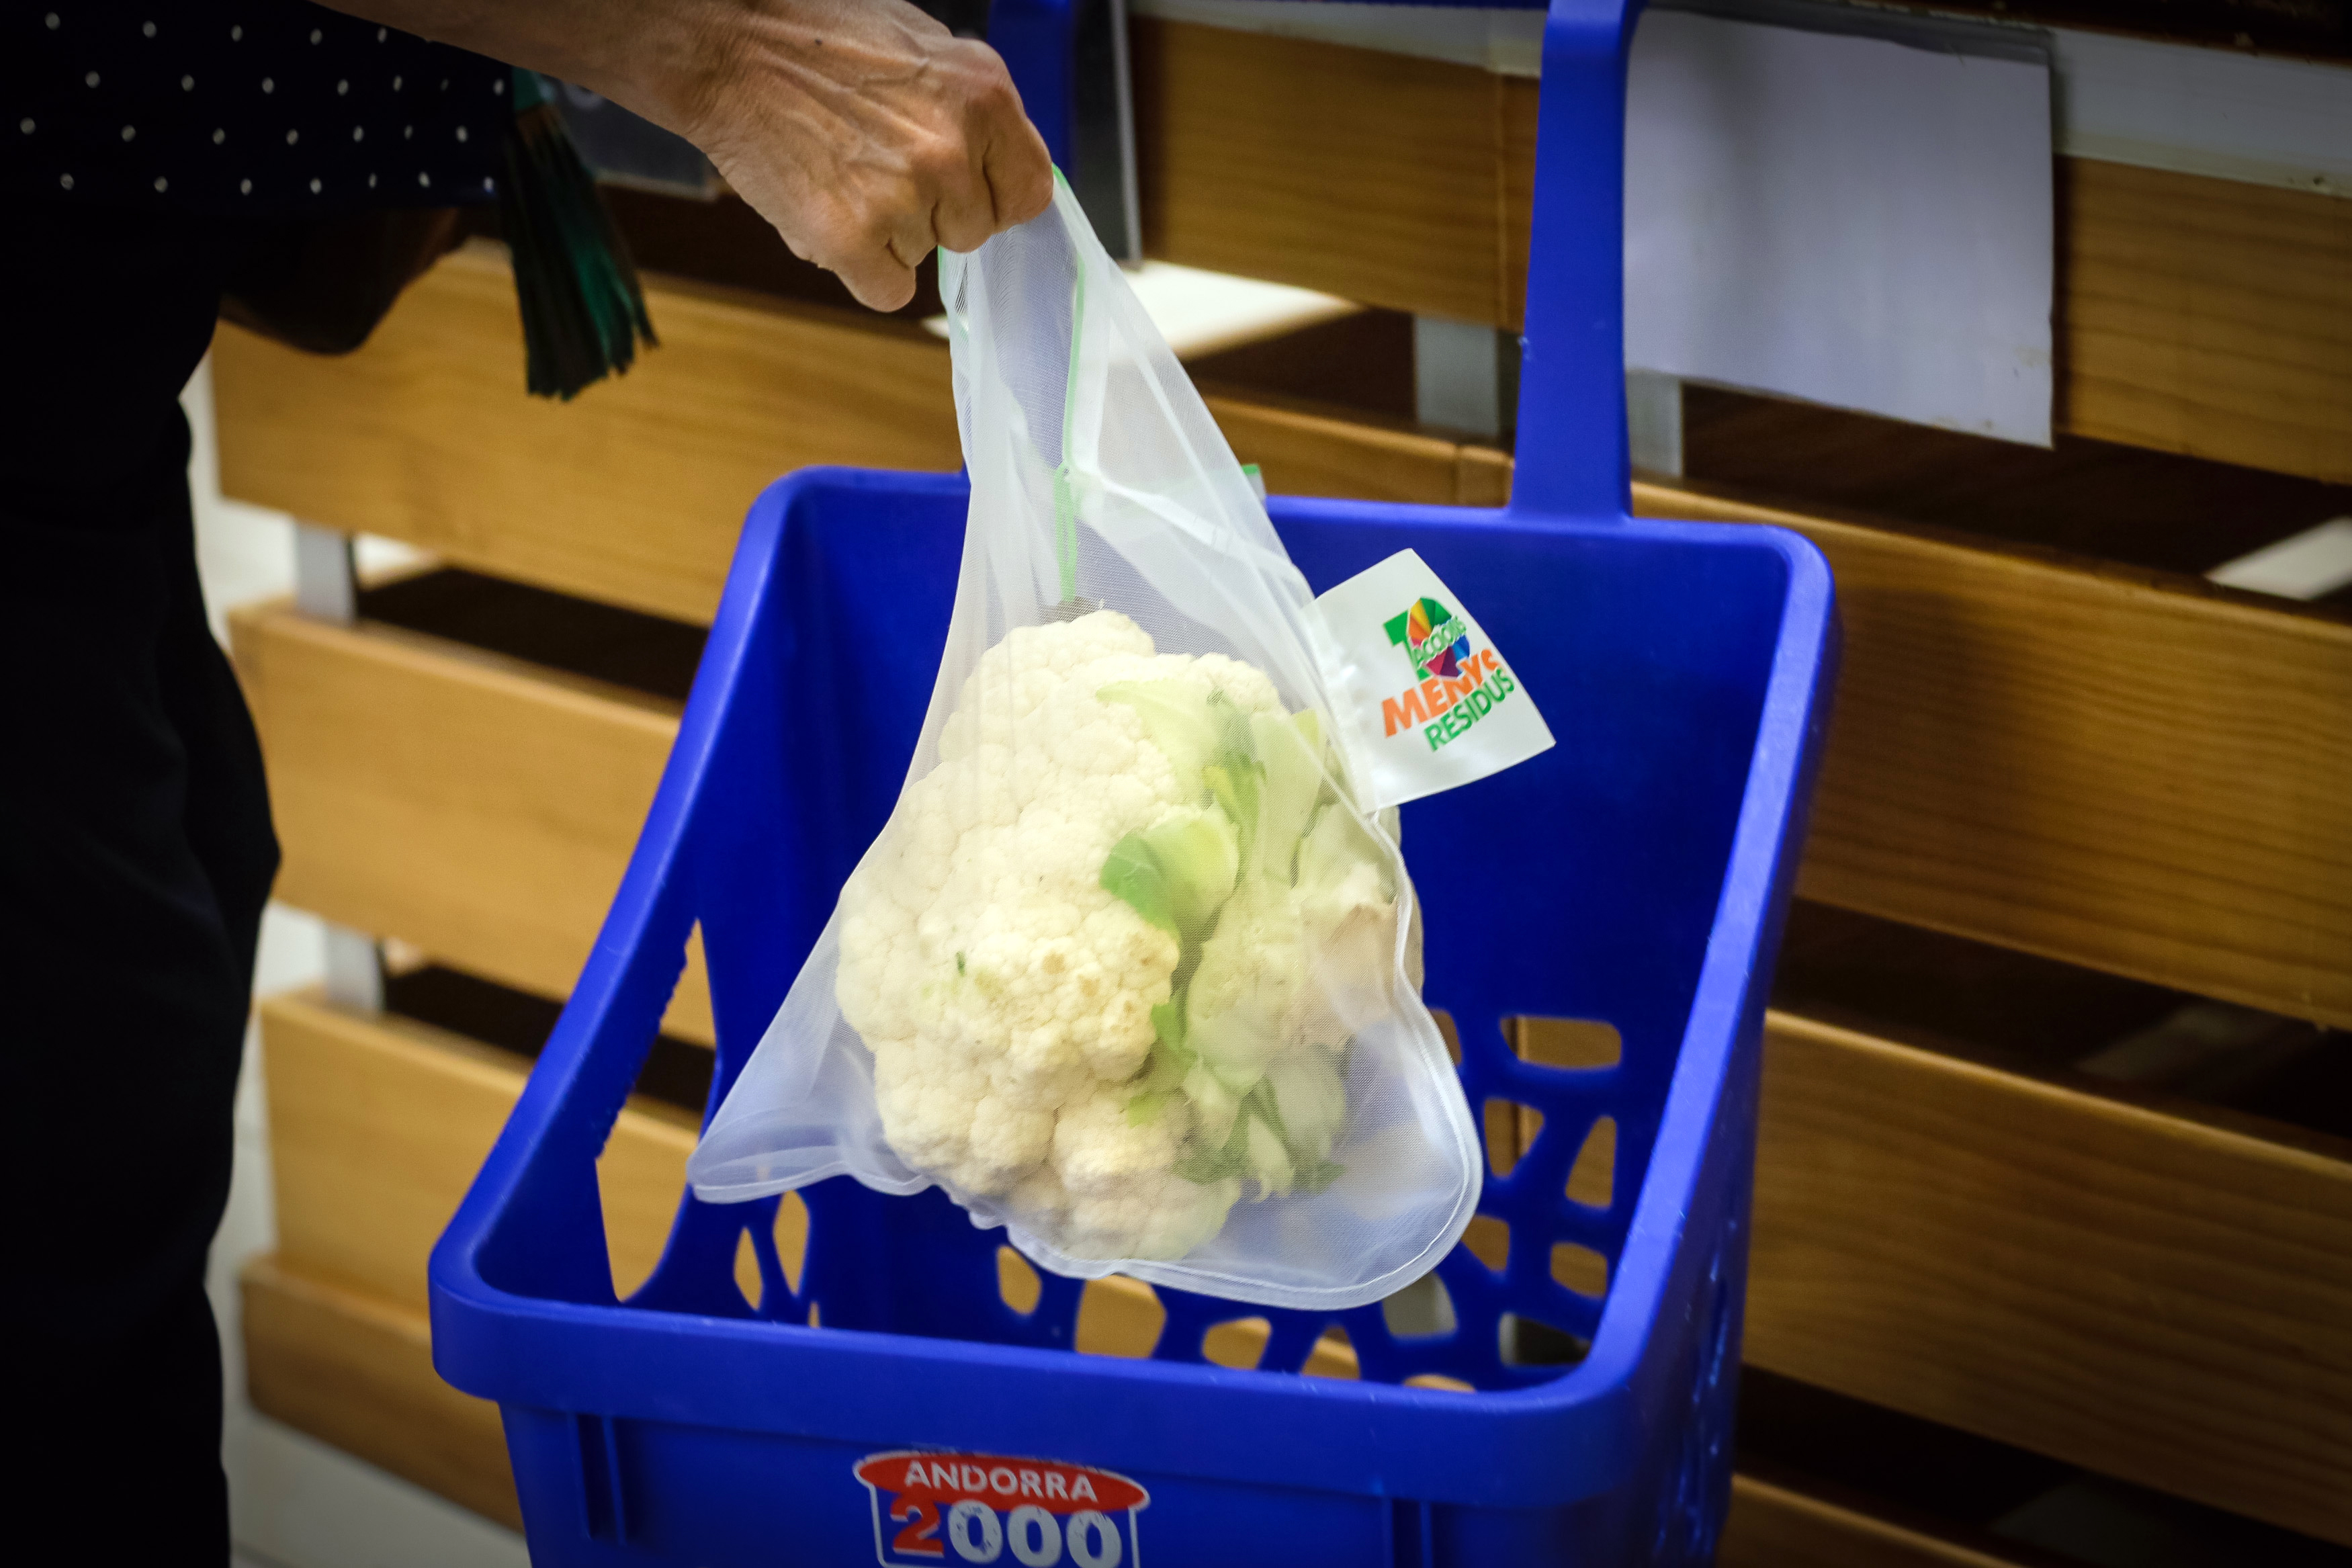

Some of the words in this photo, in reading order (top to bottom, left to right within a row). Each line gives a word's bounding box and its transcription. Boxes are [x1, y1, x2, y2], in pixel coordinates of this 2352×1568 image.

[1381, 649, 1506, 738] MENYS
[1424, 668, 1515, 752] RESIDUS
[904, 1460, 1099, 1504] ANDORRA
[890, 1493, 1123, 1568] 2000
